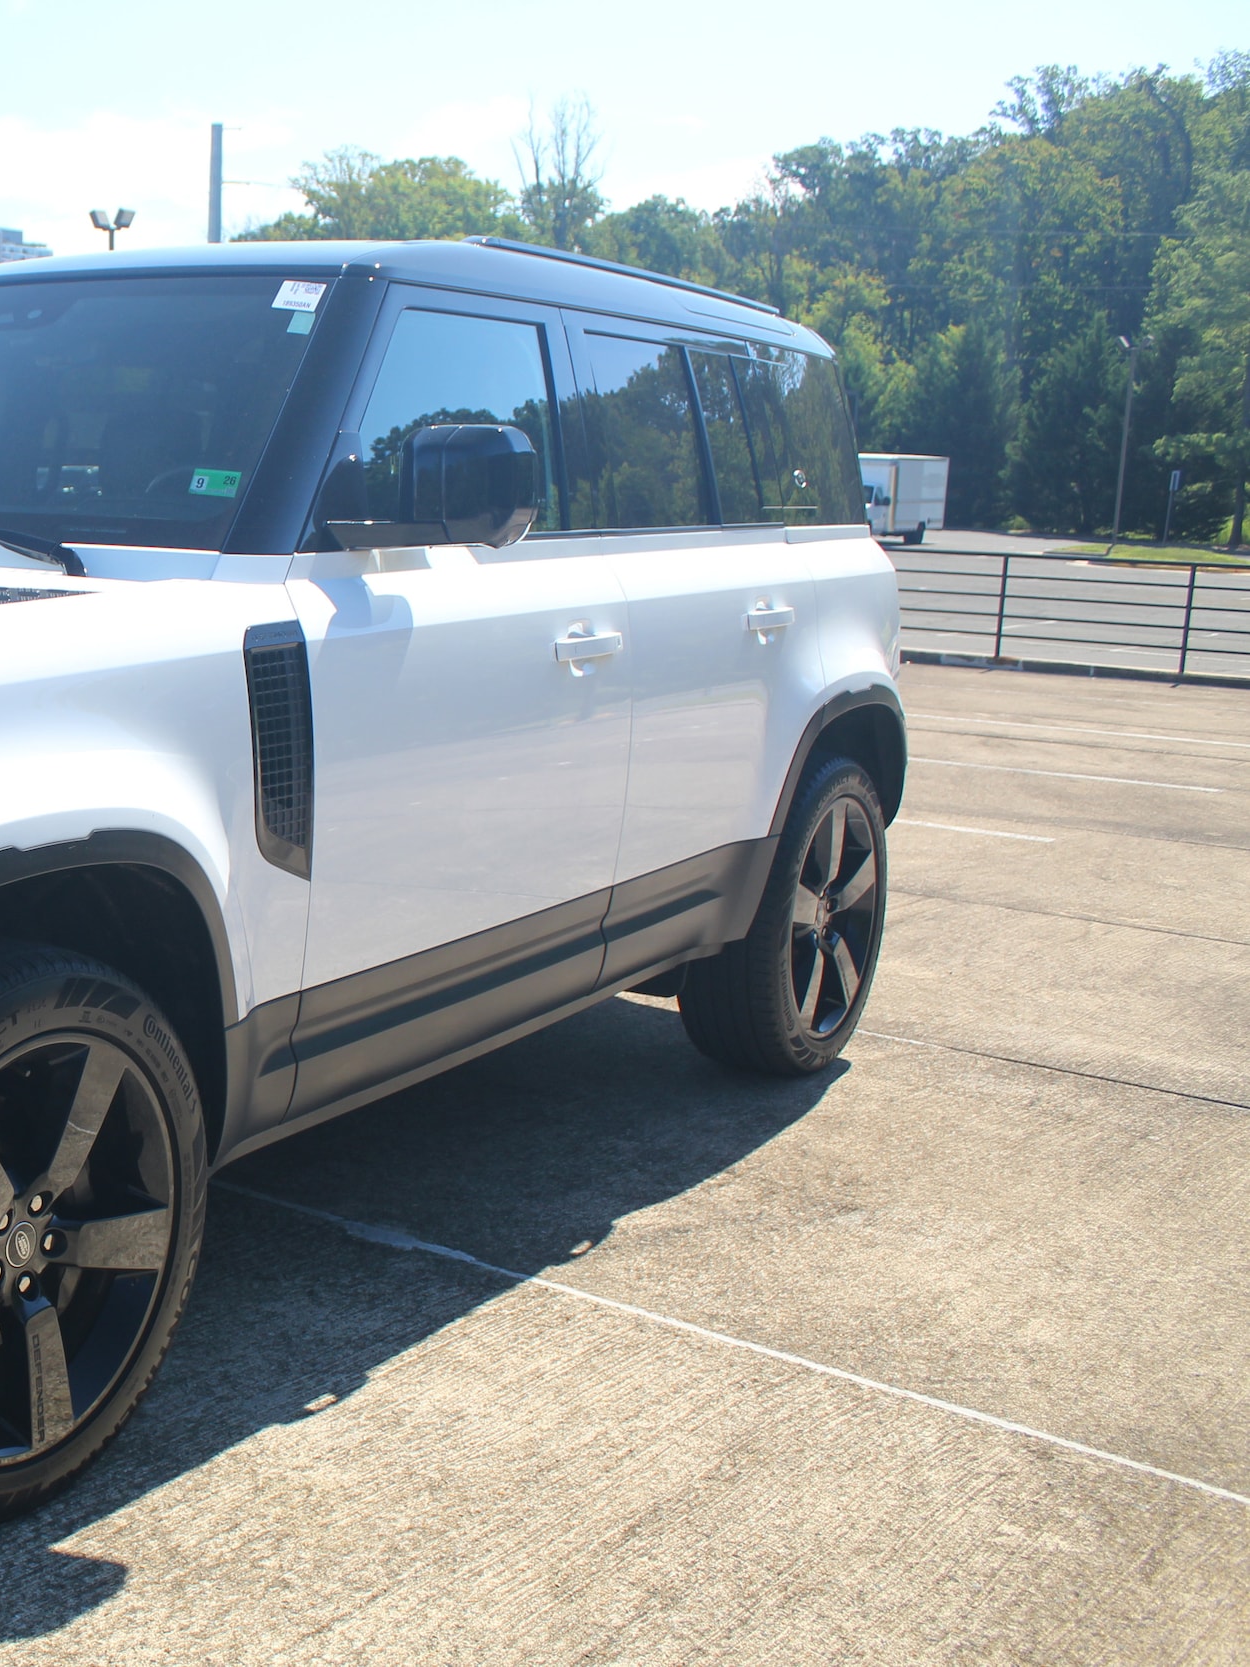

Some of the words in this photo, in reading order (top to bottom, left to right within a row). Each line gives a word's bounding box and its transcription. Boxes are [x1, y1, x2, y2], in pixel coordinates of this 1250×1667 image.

[195, 477, 205, 489] 9
[223, 475, 237, 486] 26
[143, 1013, 195, 1102] Continental
[32, 1332, 46, 1443] DEFENDER
